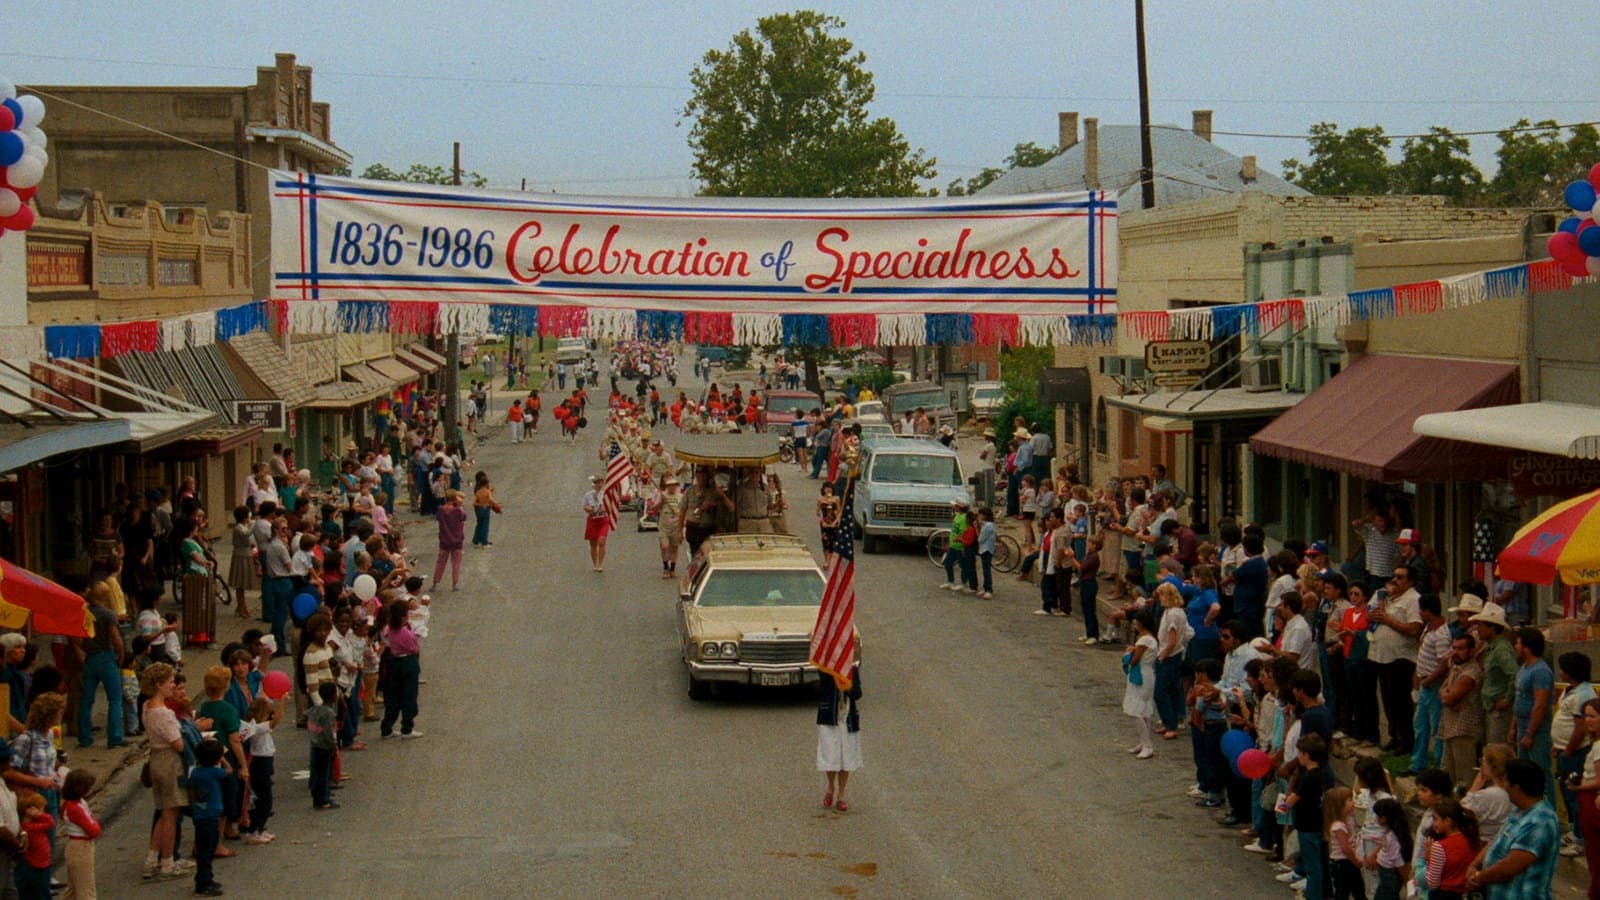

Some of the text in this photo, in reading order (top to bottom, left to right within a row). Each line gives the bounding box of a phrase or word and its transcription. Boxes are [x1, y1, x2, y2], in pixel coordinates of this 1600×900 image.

[329, 220, 1080, 293] 1836-1986 Celebration of Specialness
